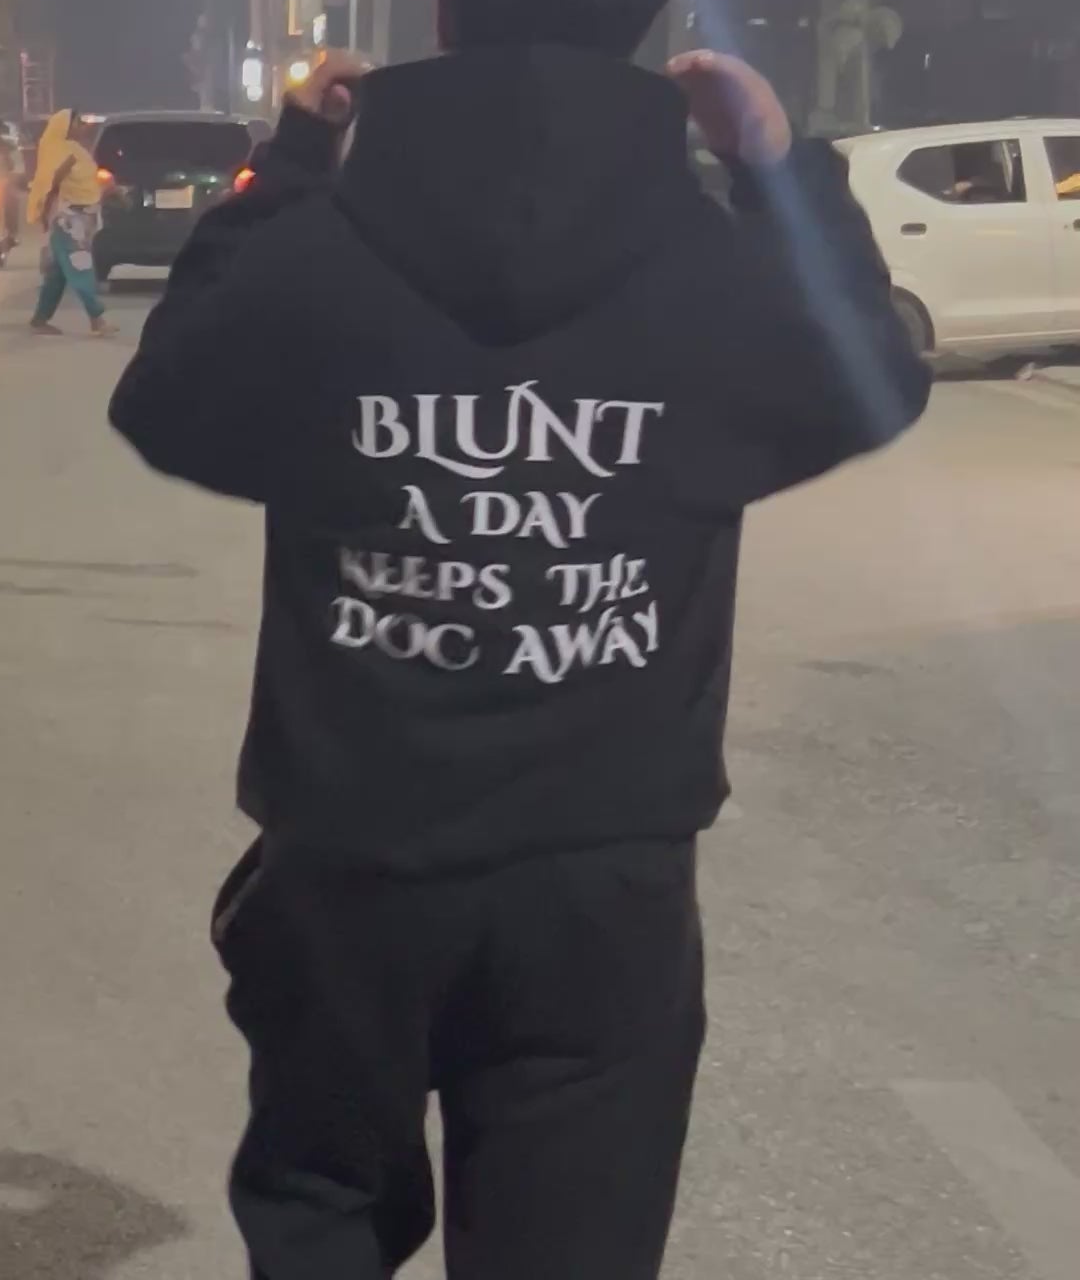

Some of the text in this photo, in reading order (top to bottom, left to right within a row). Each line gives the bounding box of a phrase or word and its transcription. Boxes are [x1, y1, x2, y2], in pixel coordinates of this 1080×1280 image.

[352, 380, 664, 479] BLUNT
[398, 485, 603, 548] A DAY
[340, 546, 649, 613] KEEPS THE
[330, 596, 659, 684] DOC AWAY
